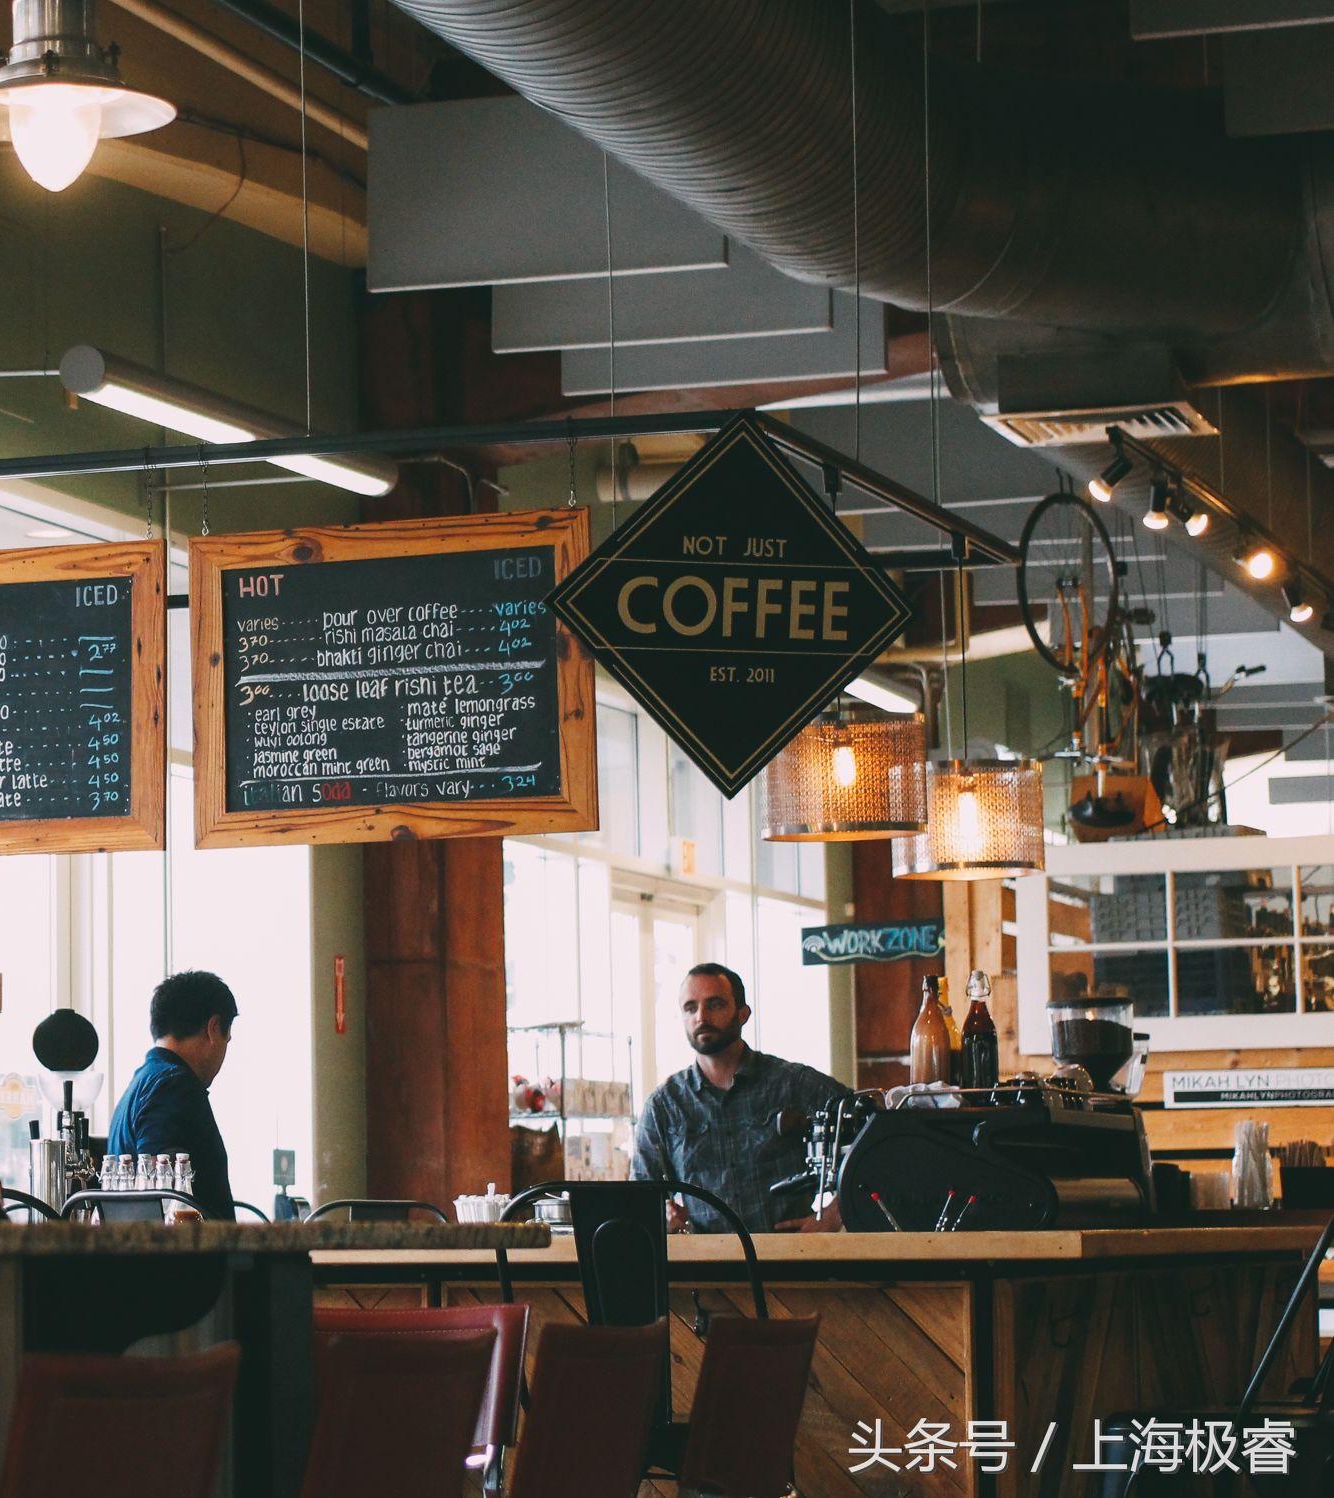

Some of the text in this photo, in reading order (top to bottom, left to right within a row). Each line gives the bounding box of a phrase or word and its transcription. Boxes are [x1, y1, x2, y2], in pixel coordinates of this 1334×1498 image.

[682, 536, 787, 558] NOT JUST
[494, 557, 542, 580] ICED
[76, 584, 118, 607] ICED
[239, 574, 284, 598] HOT
[237, 599, 547, 632] varies pour over coffee varies
[617, 575, 850, 641] COFFEE
[325, 626, 356, 645] rishi
[361, 623, 417, 643] masala
[423, 620, 453, 638] chai
[317, 647, 362, 667] bhakti
[368, 642, 422, 666] ginger
[426, 640, 462, 660] chai
[709, 666, 775, 683] EST. 2011
[303, 683, 349, 702] loose
[356, 678, 388, 700] leaf
[395, 676, 436, 697] rishi
[443, 674, 479, 696] tea
[255, 705, 316, 722] earl grey
[455, 696, 536, 714] lemongrass
[254, 716, 385, 736] ceylon single estate
[405, 712, 504, 731] turmeric ginger
[287, 732, 327, 747] oolong
[407, 726, 516, 747] tangerine ginger
[253, 747, 337, 766] jasmine green
[407, 742, 501, 760] bergamot sage
[253, 757, 390, 778] moroccan mint green
[409, 756, 486, 773] mystic mint
[12, 773, 48, 790] latte
[312, 780, 351, 803] soda
[376, 780, 428, 798] flavors
[436, 780, 470, 799] vary
[1172, 1076, 1229, 1088] MIKAH
[1236, 1075, 1269, 1088] LYN
